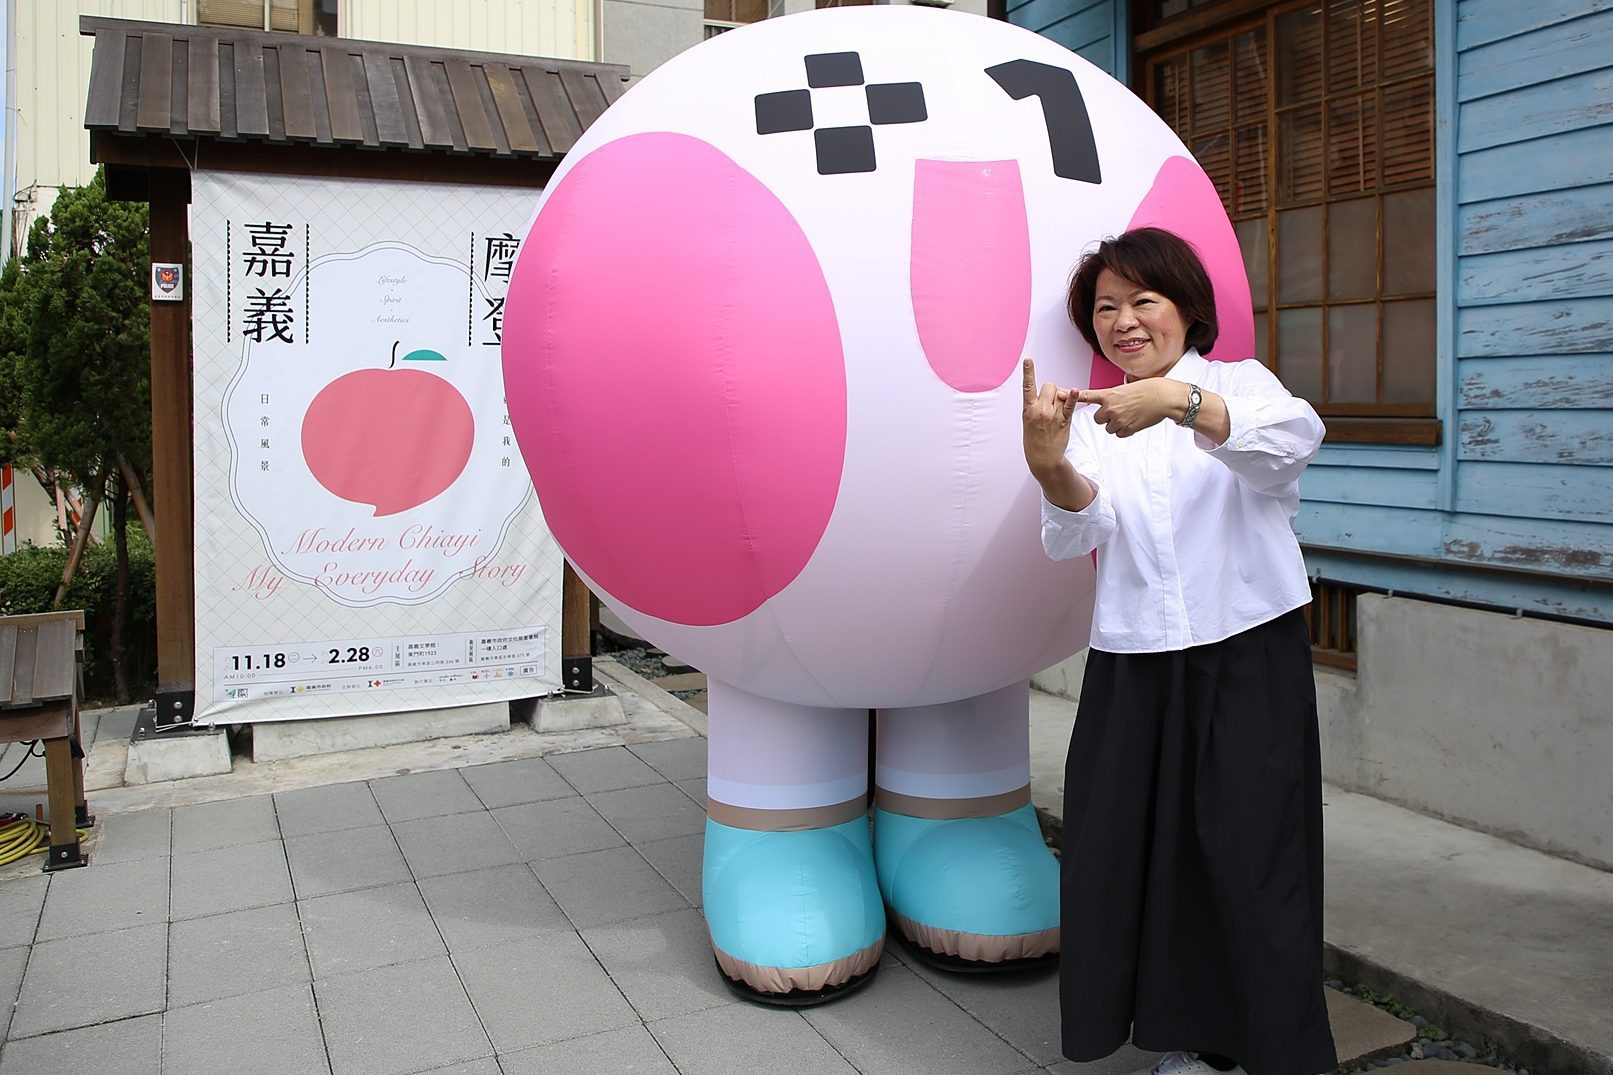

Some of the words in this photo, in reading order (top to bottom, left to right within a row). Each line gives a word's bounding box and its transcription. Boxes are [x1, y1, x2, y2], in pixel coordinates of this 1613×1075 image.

[242, 221, 295, 345] 嘉義
[260, 393, 270, 473] 日常風景
[280, 527, 385, 556] Modern
[399, 524, 482, 558] Chiayi
[232, 564, 285, 601] My
[313, 559, 436, 595] Everyday
[459, 555, 528, 588] Story
[232, 652, 286, 671] 11.18
[328, 646, 370, 664] 2.28
